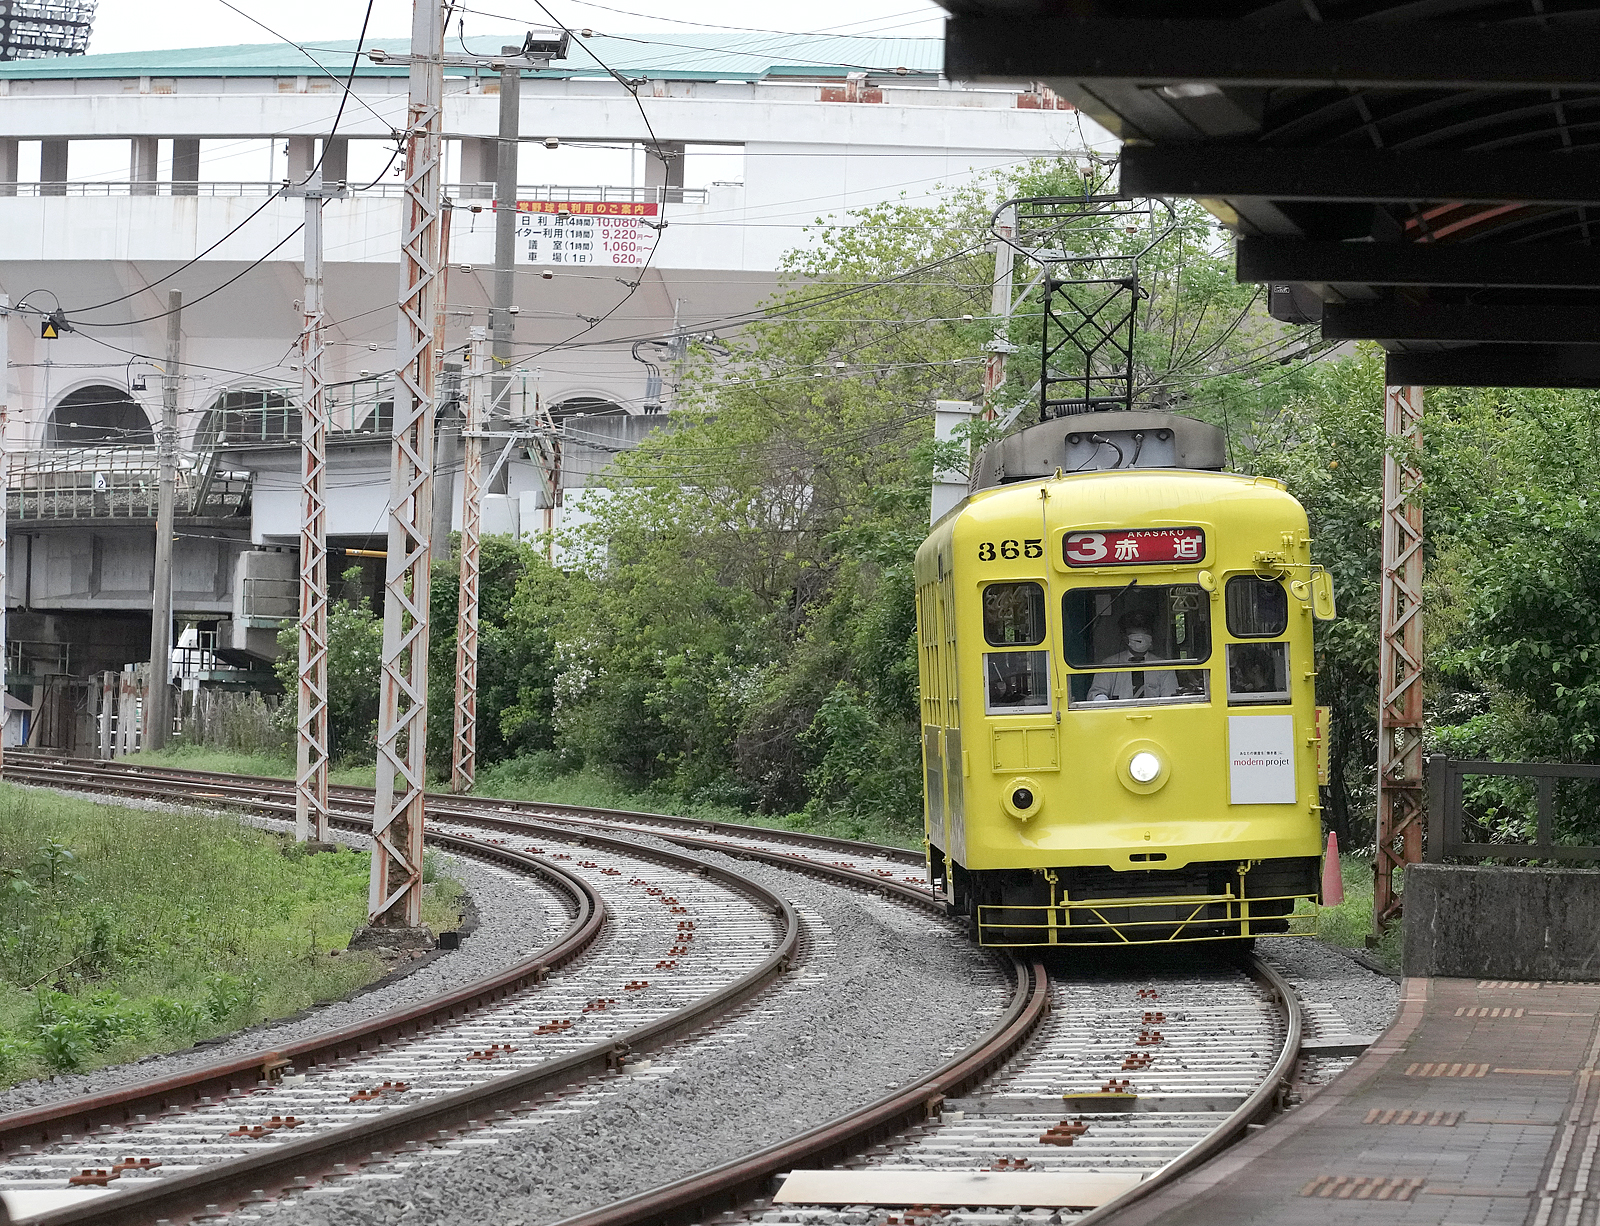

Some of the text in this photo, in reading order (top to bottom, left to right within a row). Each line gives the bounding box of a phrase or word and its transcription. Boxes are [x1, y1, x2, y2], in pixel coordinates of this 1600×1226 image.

[98, 479, 104, 488] 2
[1127, 530, 1184, 538] AKASAKO
[978, 538, 1043, 561] 365
[1066, 533, 1108, 561] 3
[1233, 757, 1289, 767] modern projet
